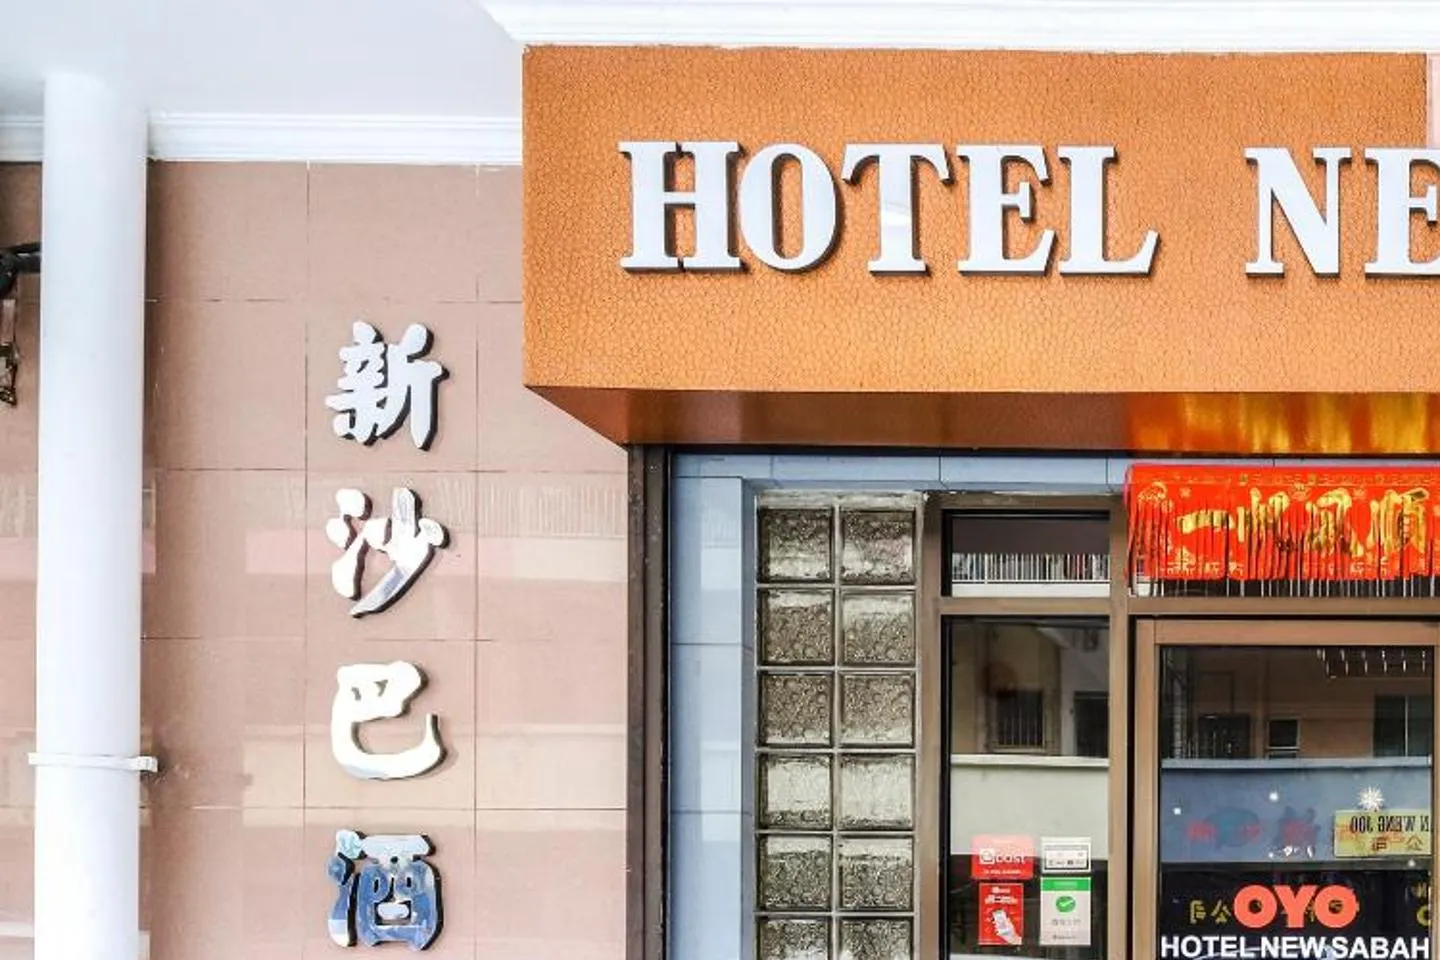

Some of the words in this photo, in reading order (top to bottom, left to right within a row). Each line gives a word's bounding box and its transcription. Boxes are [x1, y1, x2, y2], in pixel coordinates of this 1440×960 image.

[617, 140, 1160, 277] HOTEL
[1233, 884, 1360, 930] OYO
[1160, 935, 1256, 959] HOTEL
[1260, 936, 1327, 959] NEW
[1330, 936, 1431, 959] SABAH
